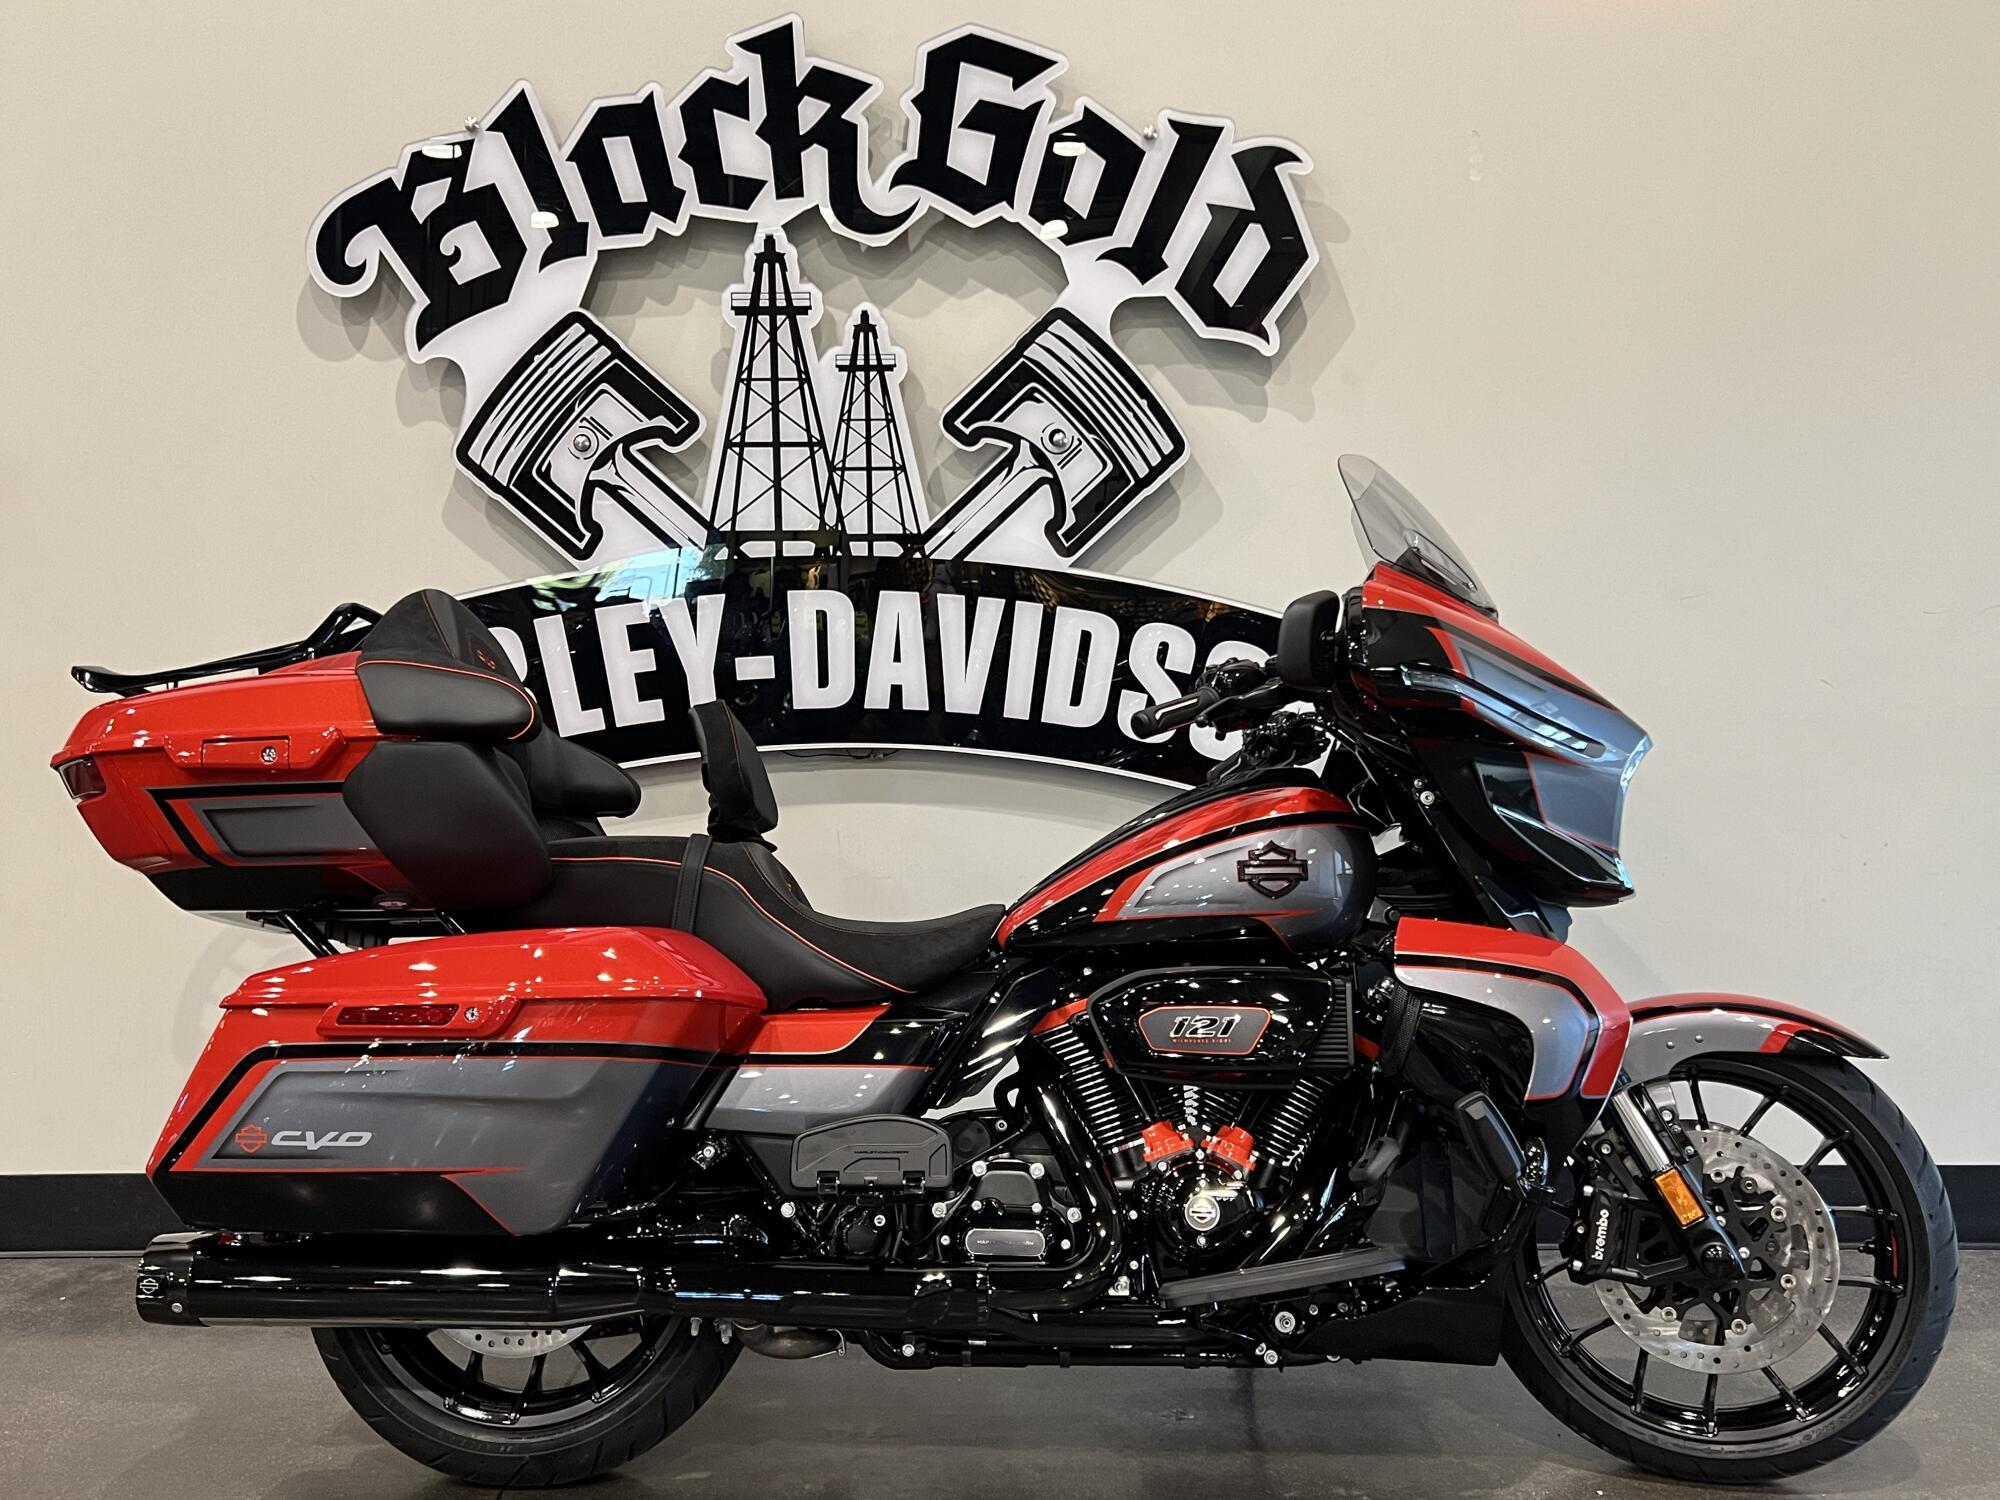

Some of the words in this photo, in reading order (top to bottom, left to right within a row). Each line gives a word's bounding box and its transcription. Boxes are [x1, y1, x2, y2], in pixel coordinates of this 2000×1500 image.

[315, 19, 921, 352] Black
[889, 33, 1310, 344] Gold
[487, 589, 1335, 778] LEY-DAVIDS
[1169, 1014, 1241, 1038] 121
[271, 1130, 373, 1151] CVO
[1591, 1208, 1610, 1261] brembo
